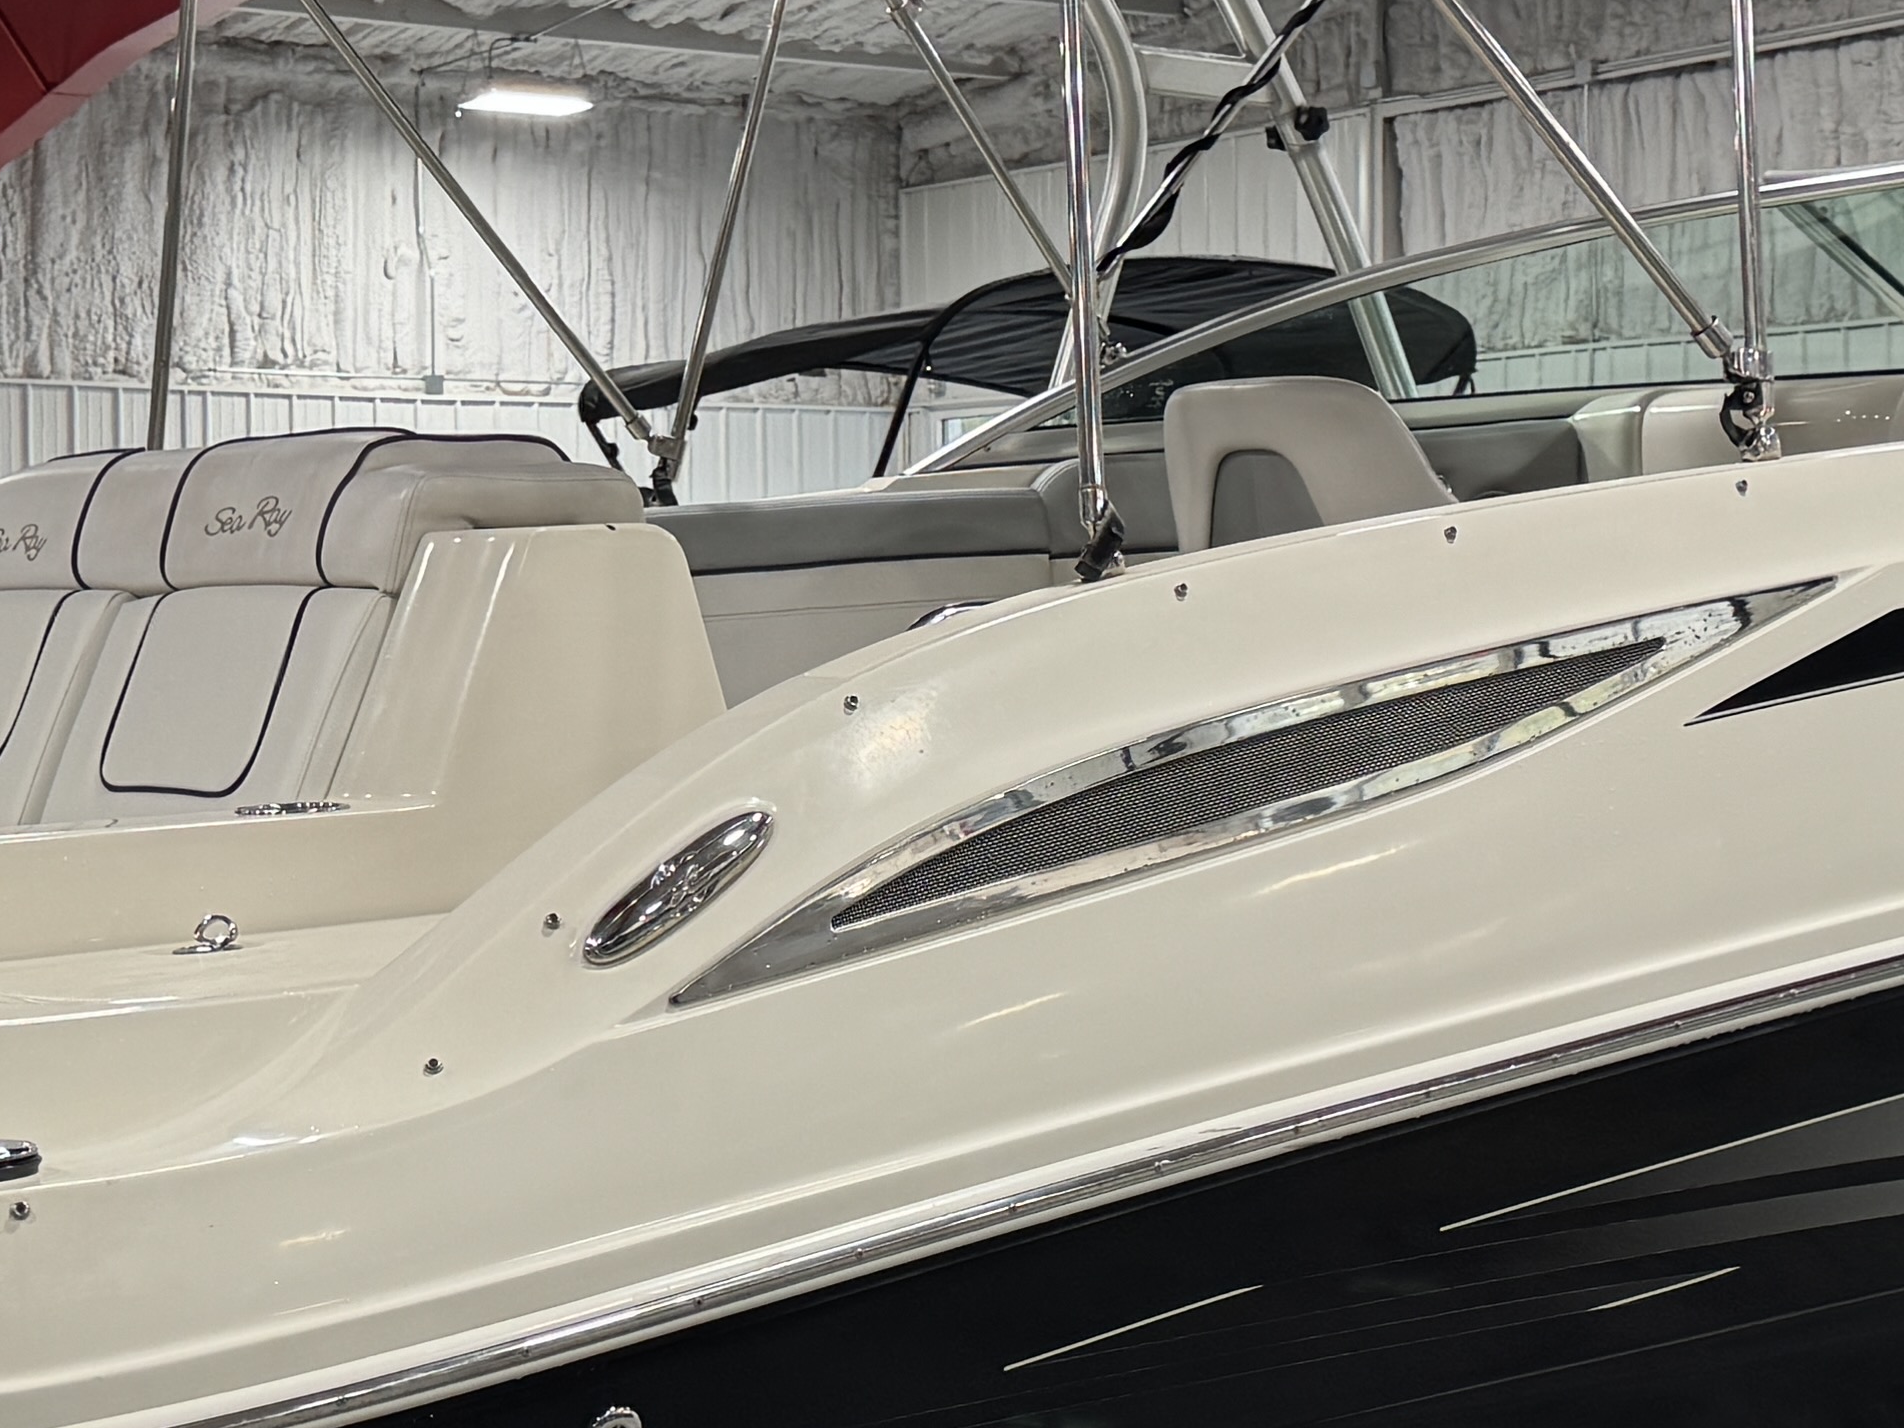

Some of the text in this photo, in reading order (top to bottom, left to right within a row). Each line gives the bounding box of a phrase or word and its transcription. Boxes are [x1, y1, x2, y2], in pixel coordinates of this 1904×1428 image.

[204, 495, 293, 538] Sea Ray
[12, 523, 48, 562] Ray
